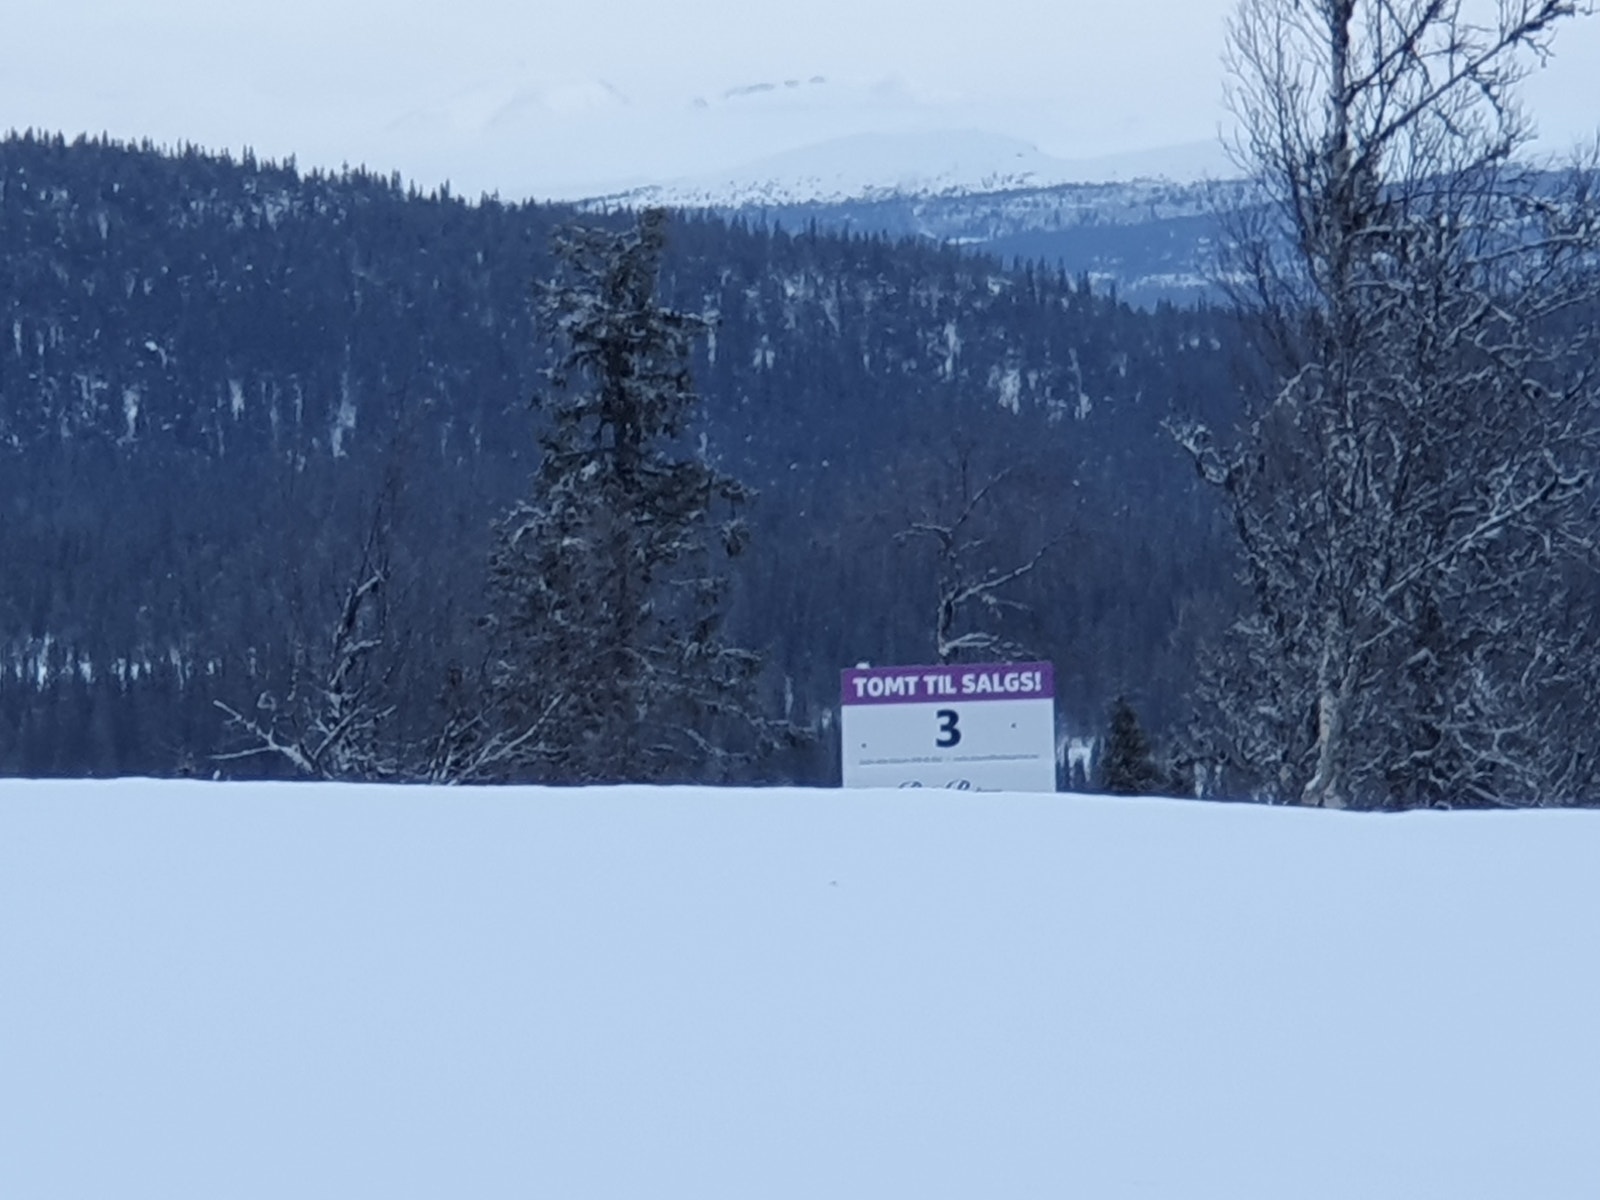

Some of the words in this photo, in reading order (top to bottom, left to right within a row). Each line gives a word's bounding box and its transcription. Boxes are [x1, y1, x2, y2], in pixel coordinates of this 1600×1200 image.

[853, 676, 919, 697] TOMT
[923, 674, 956, 695] TIL
[962, 671, 1042, 693] SALGS!
[935, 709, 962, 748] 3
